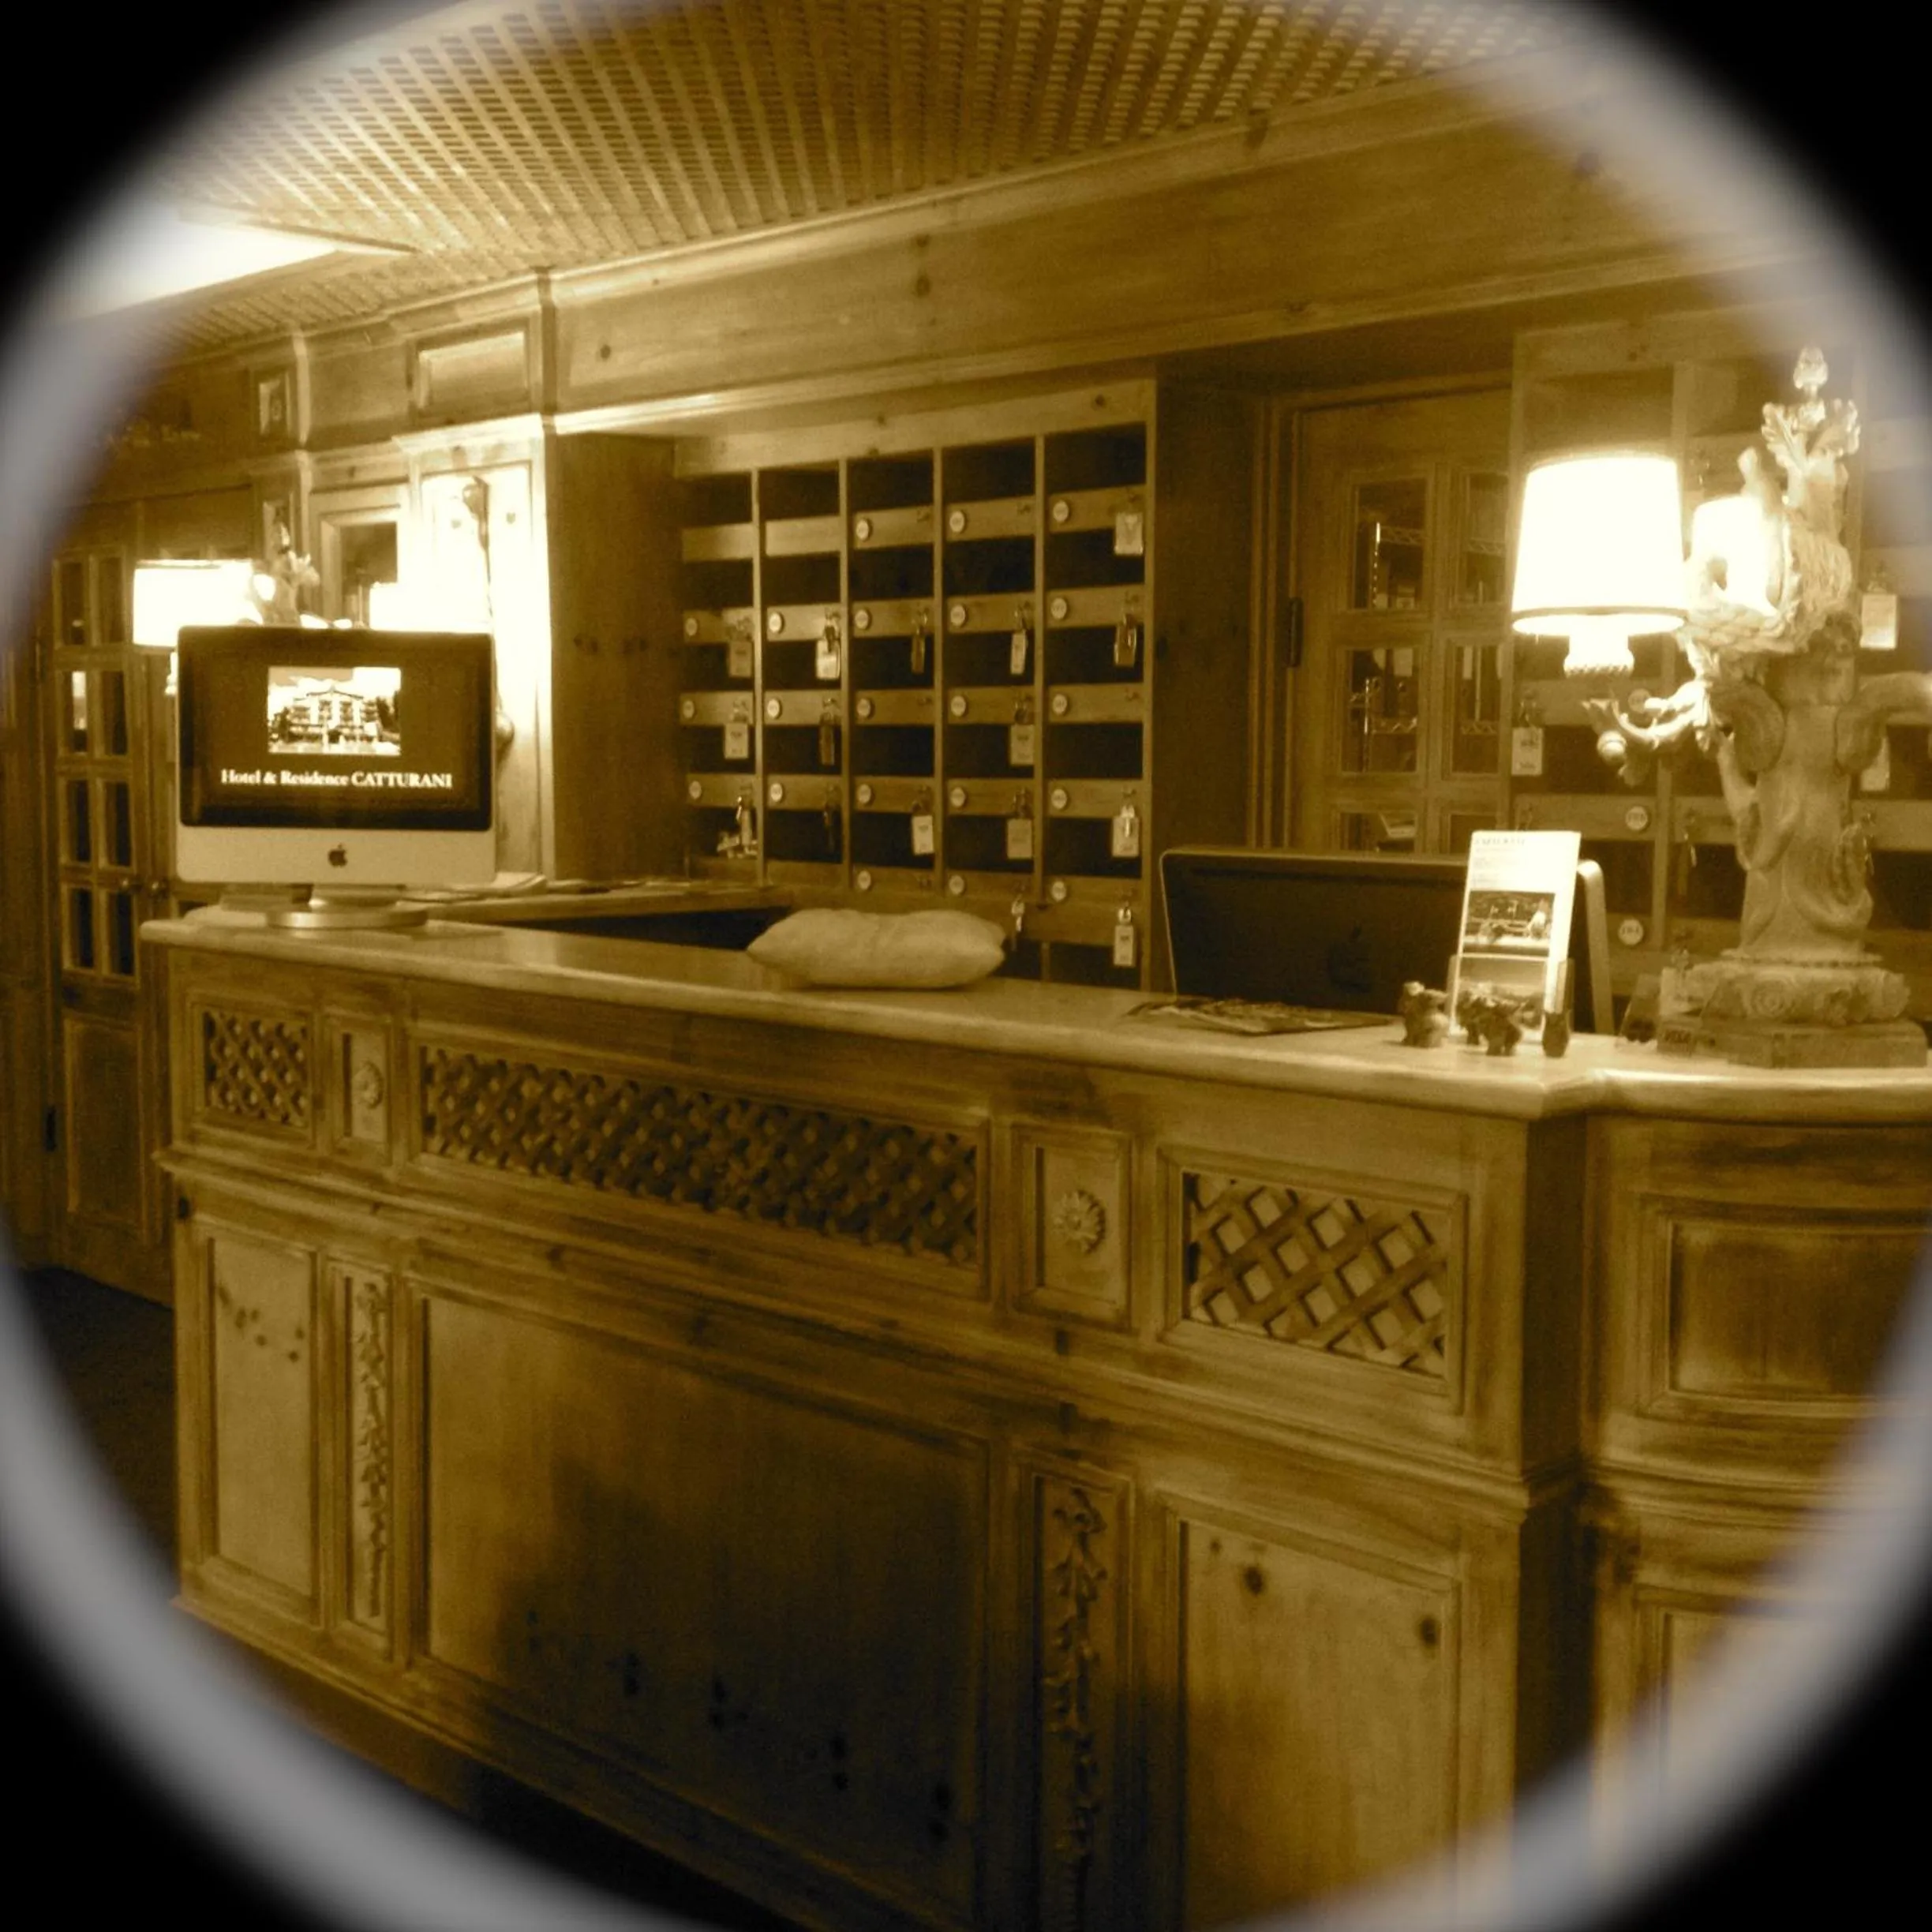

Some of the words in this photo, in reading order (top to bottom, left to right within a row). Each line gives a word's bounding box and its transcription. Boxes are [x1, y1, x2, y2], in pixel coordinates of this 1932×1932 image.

[220, 769, 261, 784] Hotel
[263, 771, 276, 784] &
[280, 770, 349, 786] Residence
[351, 771, 453, 788] CATTURANI
